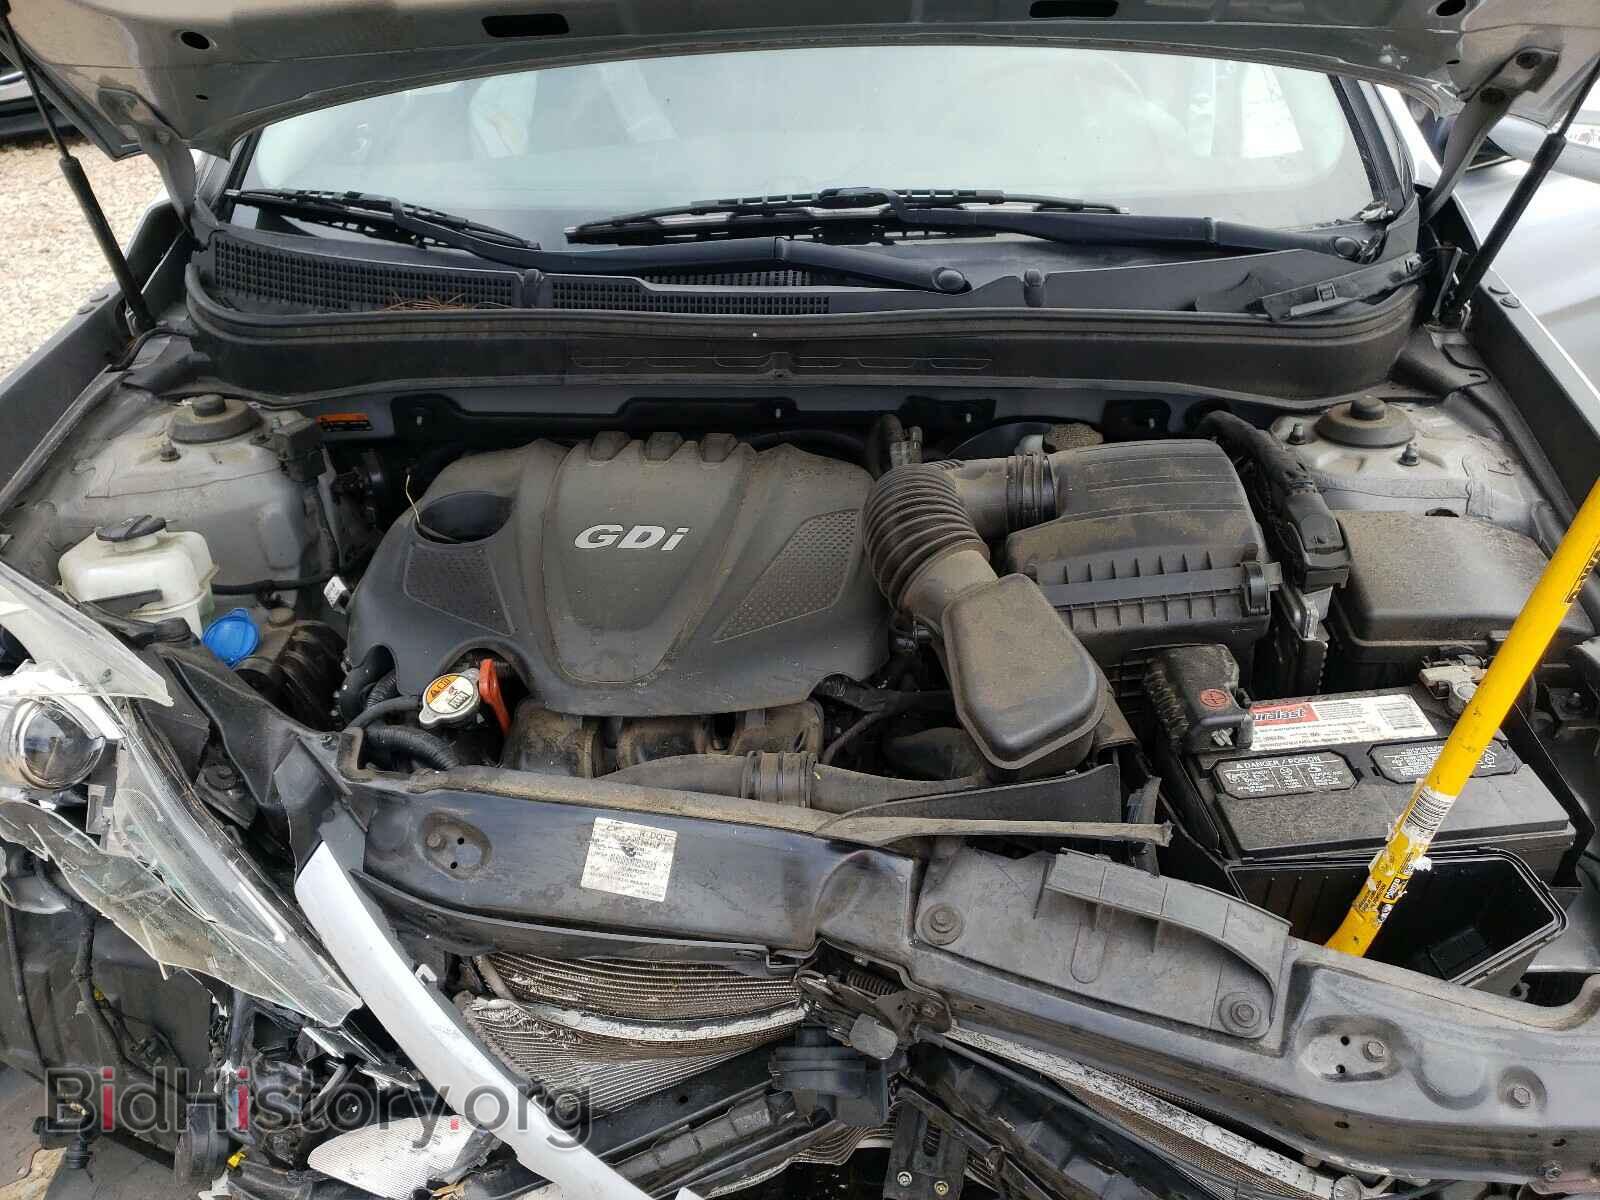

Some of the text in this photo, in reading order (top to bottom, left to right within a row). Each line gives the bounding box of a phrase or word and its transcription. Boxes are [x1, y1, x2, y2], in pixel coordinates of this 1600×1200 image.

[574, 524, 689, 551] GDi
[1253, 708, 1304, 721] uralast
[1245, 759, 1280, 769] DANGER
